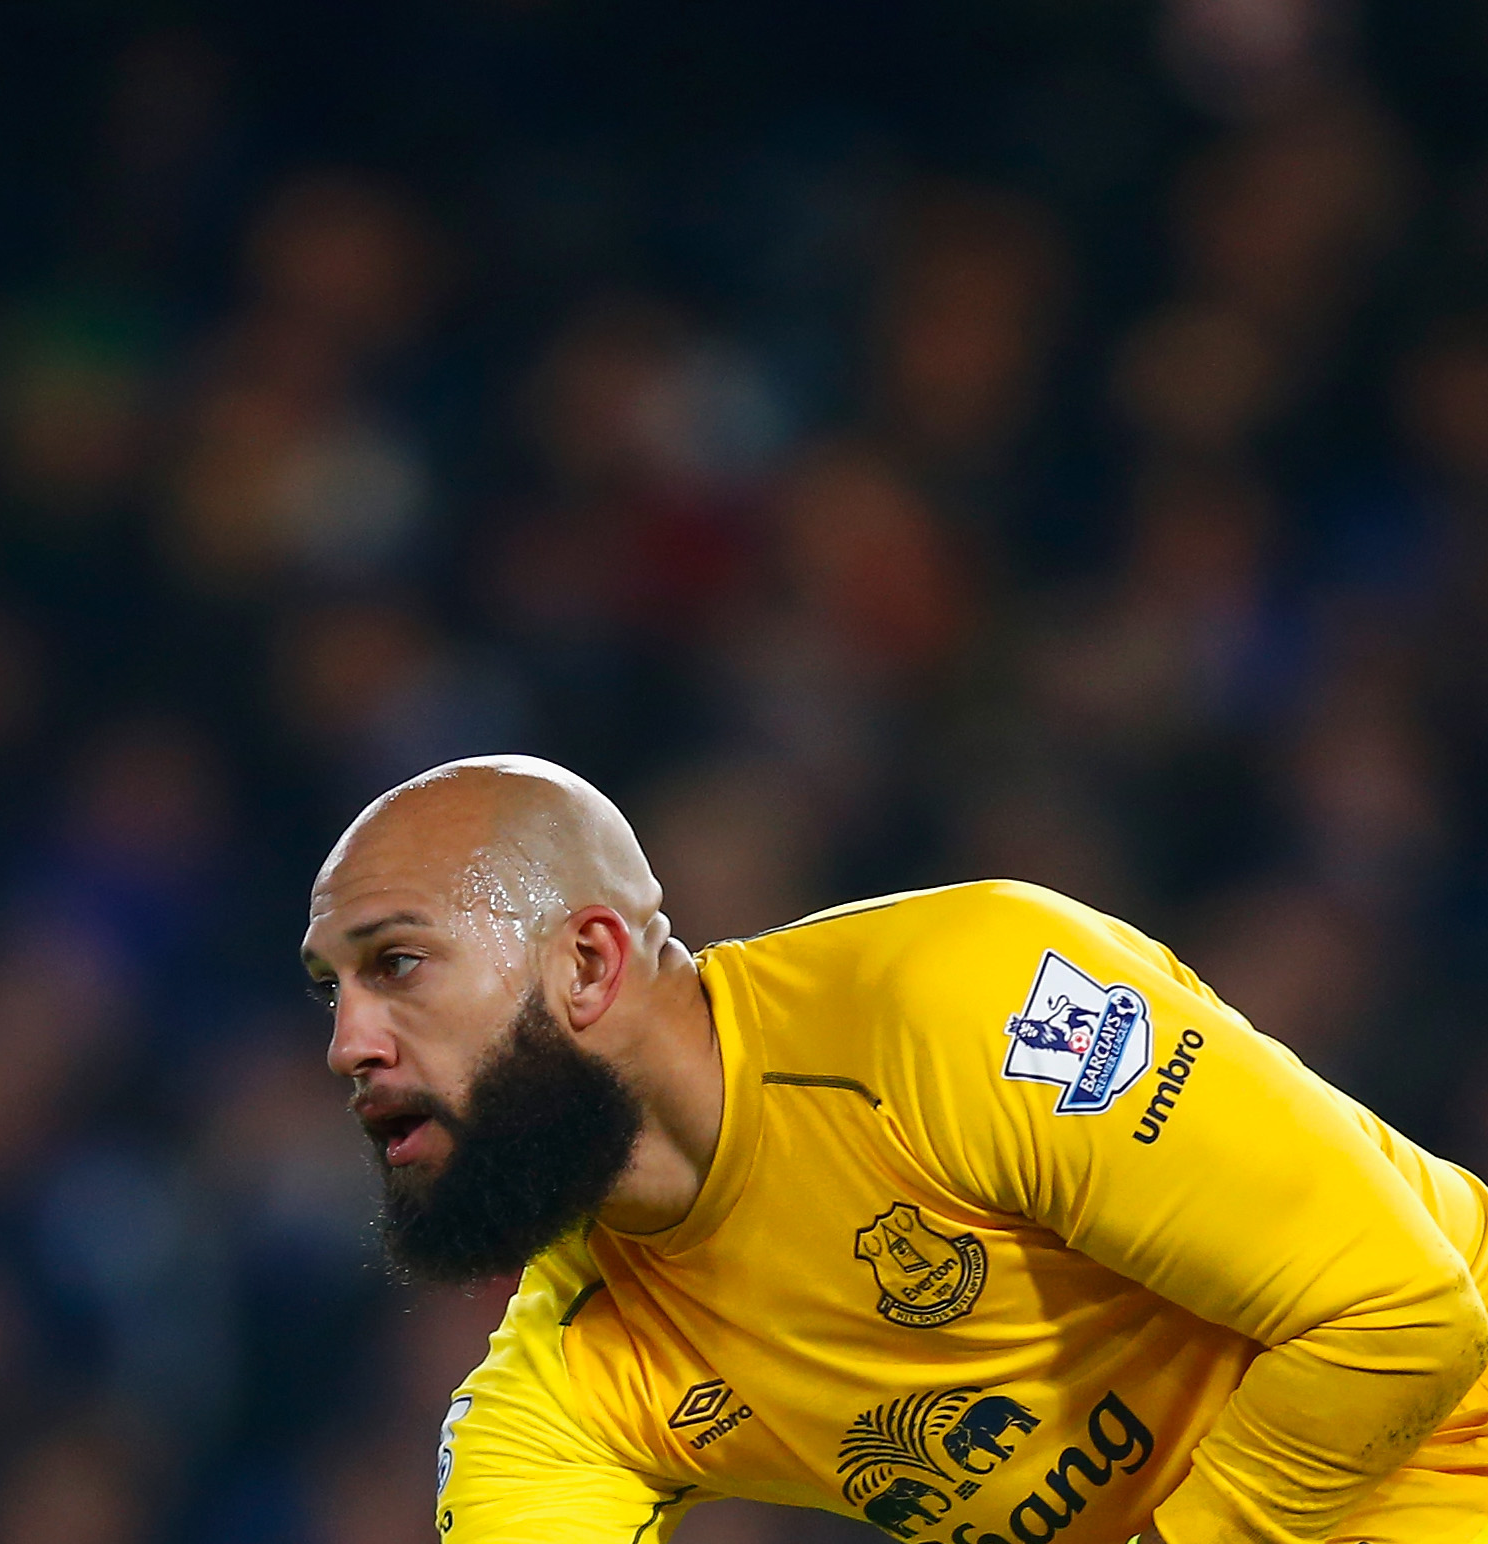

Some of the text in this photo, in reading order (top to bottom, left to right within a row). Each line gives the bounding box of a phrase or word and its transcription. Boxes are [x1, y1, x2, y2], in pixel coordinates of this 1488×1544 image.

[1079, 1013, 1121, 1093] BARCLAYS
[1092, 1019, 1132, 1099] PREMIER LEAGUE
[1132, 1029, 1204, 1145] umbro
[901, 1258, 959, 1301] Everton
[689, 1404, 753, 1449] umbro
